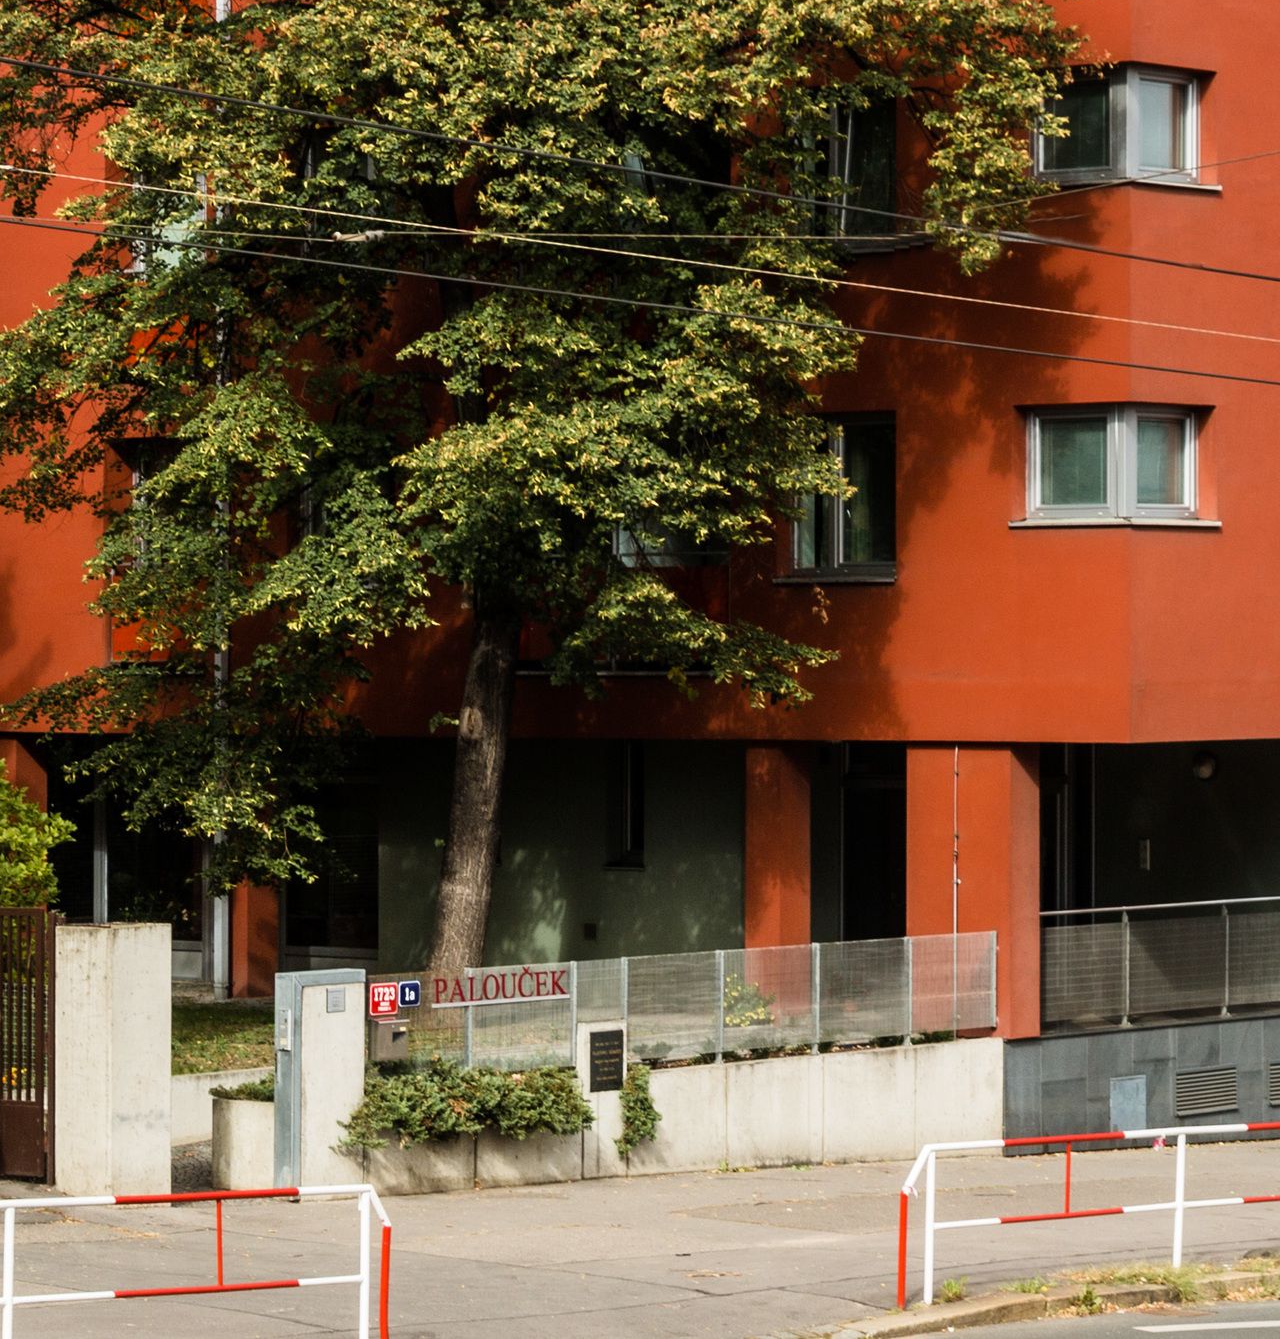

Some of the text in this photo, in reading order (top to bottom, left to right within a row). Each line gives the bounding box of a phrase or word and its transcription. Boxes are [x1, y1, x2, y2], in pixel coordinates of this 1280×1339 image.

[433, 966, 567, 1003] PALOUČEK
[373, 987, 395, 1001] 1723
[405, 987, 415, 1001] 1a
